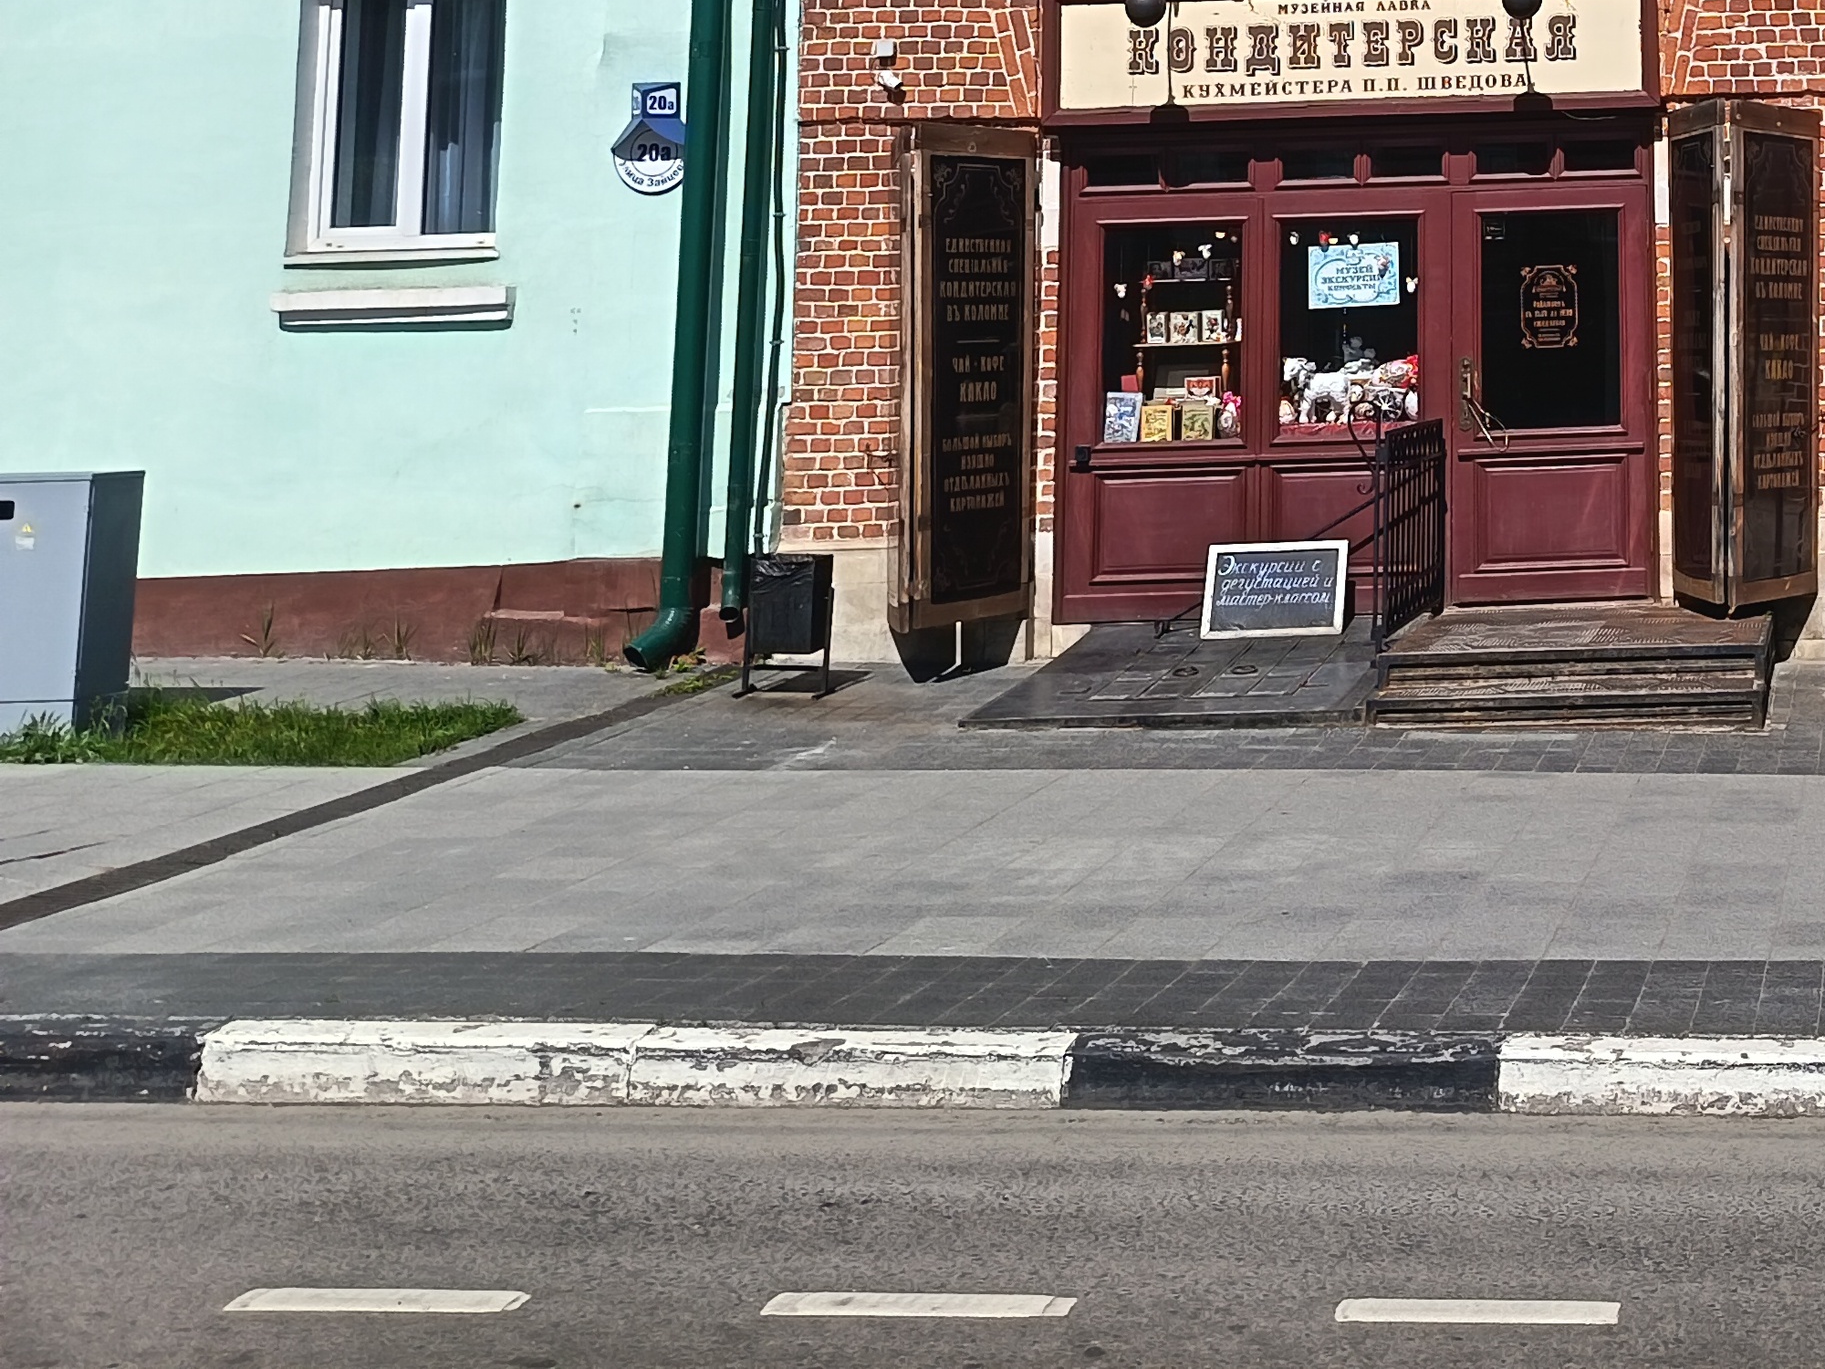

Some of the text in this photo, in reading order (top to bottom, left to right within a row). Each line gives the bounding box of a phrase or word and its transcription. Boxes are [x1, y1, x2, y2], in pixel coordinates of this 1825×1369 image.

[1278, 0, 1431, 14] МУЗЕЙНАЯ ЛАВКА
[1127, 13, 1577, 76] КОНДИТЕРСКАЯ
[1182, 80, 1352, 98] КУХМЕЙСТЕРА
[1417, 73, 1527, 91] ШВЕДОВА
[648, 95, 675, 110] 20а
[636, 143, 672, 162] 20а
[1336, 264, 1373, 275] МУЗЕЙ
[939, 280, 1016, 298] КОНДИТЕРСКАЯ
[946, 304, 961, 322] ВЪ
[952, 354, 1004, 373] ЧАЙ КОФЕ
[1765, 359, 1793, 380] КАКАО
[959, 381, 997, 402] КАКАО
[1218, 555, 1322, 579] Экскурсии с
[1220, 573, 1334, 596] дегустацией и
